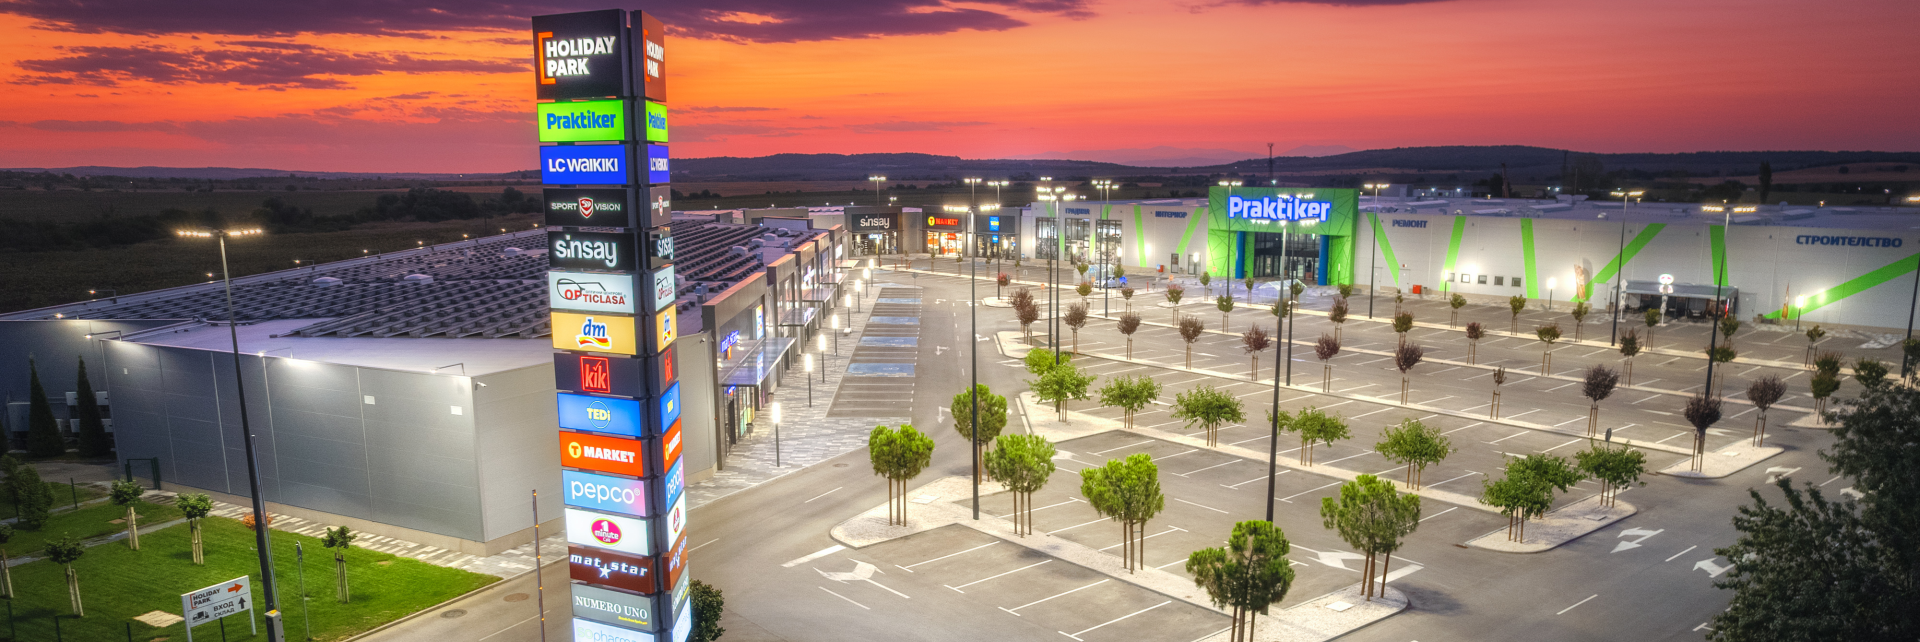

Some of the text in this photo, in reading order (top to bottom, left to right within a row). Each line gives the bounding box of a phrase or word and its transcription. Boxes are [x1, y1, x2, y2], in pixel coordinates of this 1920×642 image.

[545, 36, 616, 58] HOLIDAY
[646, 39, 664, 63] HOLIDAY
[547, 57, 590, 77] PARK
[647, 58, 659, 78] PARK
[546, 110, 616, 130] Praktiker
[548, 158, 565, 173] LC
[551, 202, 620, 211] SPORT VISION
[1229, 195, 1331, 221] Praktiker
[860, 215, 890, 229] sinsay
[1392, 219, 1428, 229] РЕМОНТ
[1796, 235, 1903, 248] СТРОИТЕЛСТВО
[555, 234, 617, 267] sinsay
[583, 318, 606, 338] dm
[587, 407, 611, 421] TEDi
[583, 446, 635, 463] MARKET
[601, 520, 609, 532] 1
[594, 529, 619, 540] minute
[569, 554, 648, 577] mat star
[193, 588, 220, 601] HOLIDAY
[194, 597, 211, 607] PARK
[213, 601, 235, 612] ВХОД
[214, 608, 235, 618] СКЛАД
[575, 596, 648, 619] NUMERO UNO
